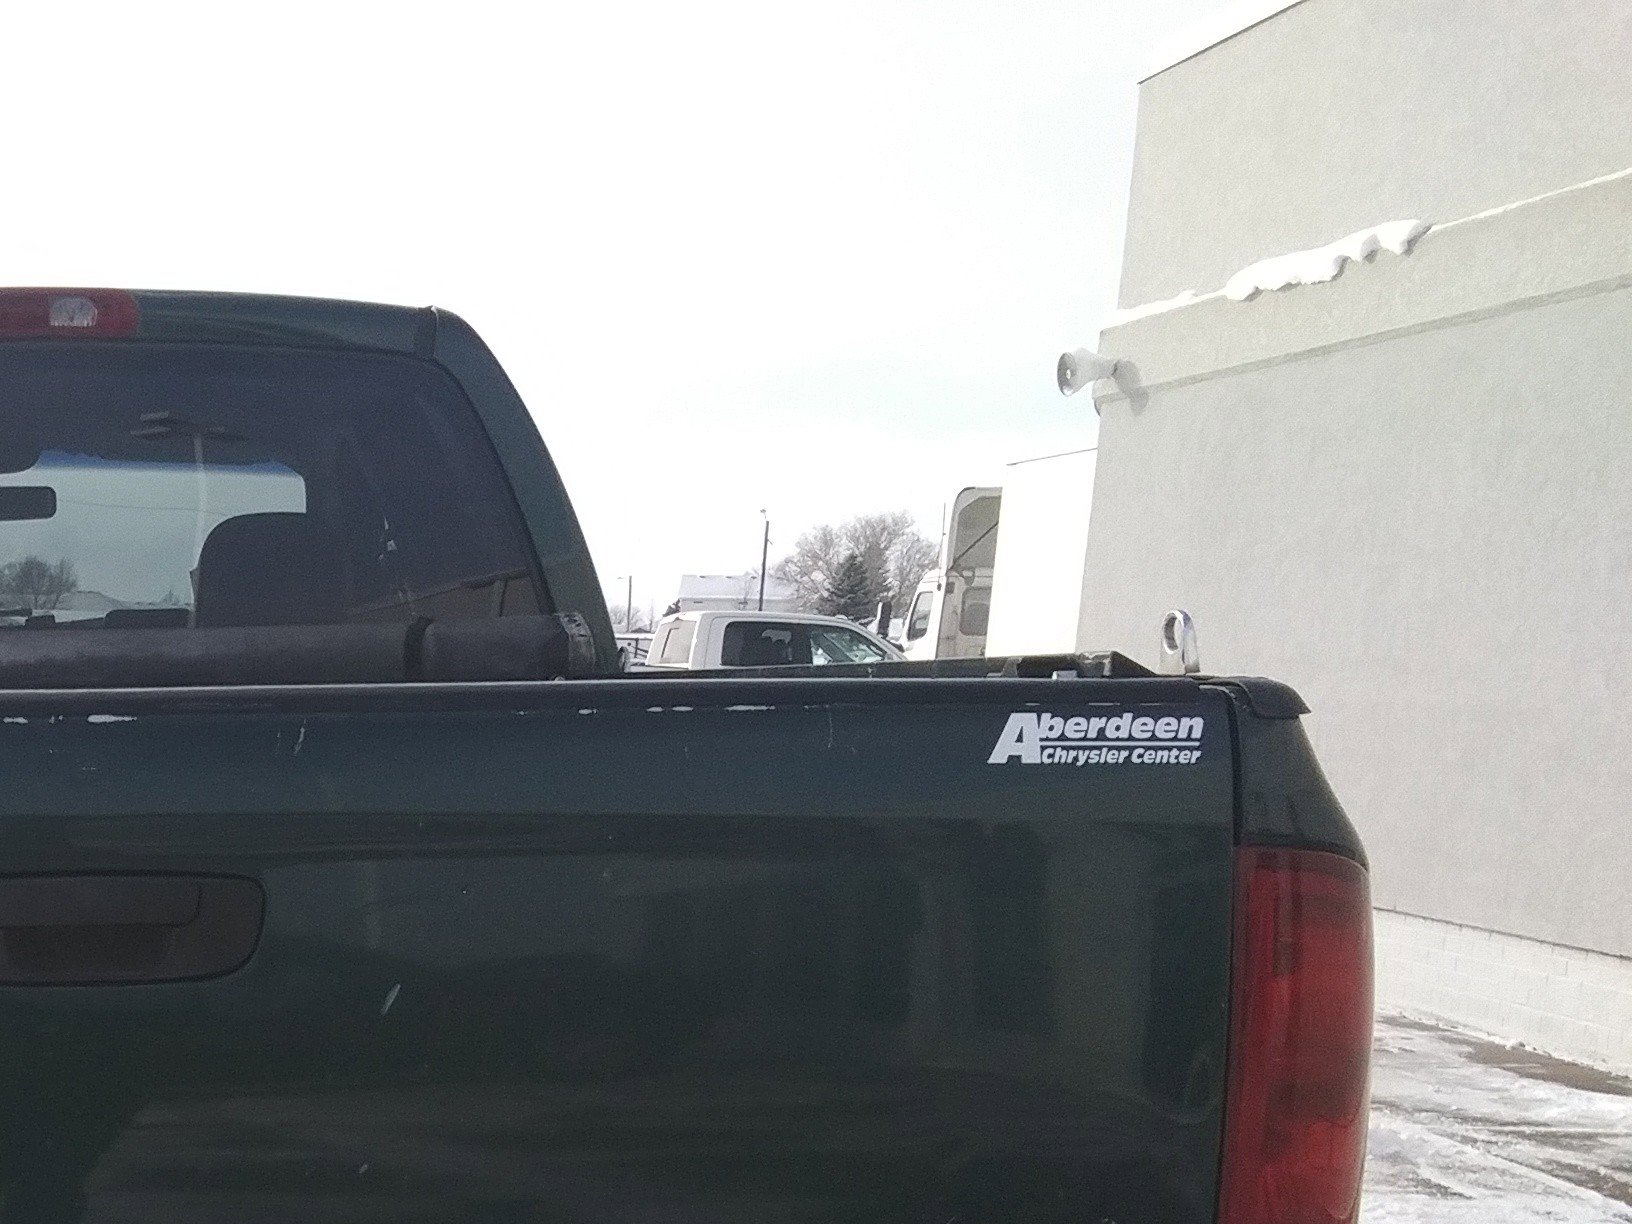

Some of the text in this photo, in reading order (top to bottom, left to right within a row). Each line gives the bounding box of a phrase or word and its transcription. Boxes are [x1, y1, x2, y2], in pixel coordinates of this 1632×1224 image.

[987, 711, 1205, 764] Aberdeen
[1041, 746, 1202, 767] Chrysler Center
